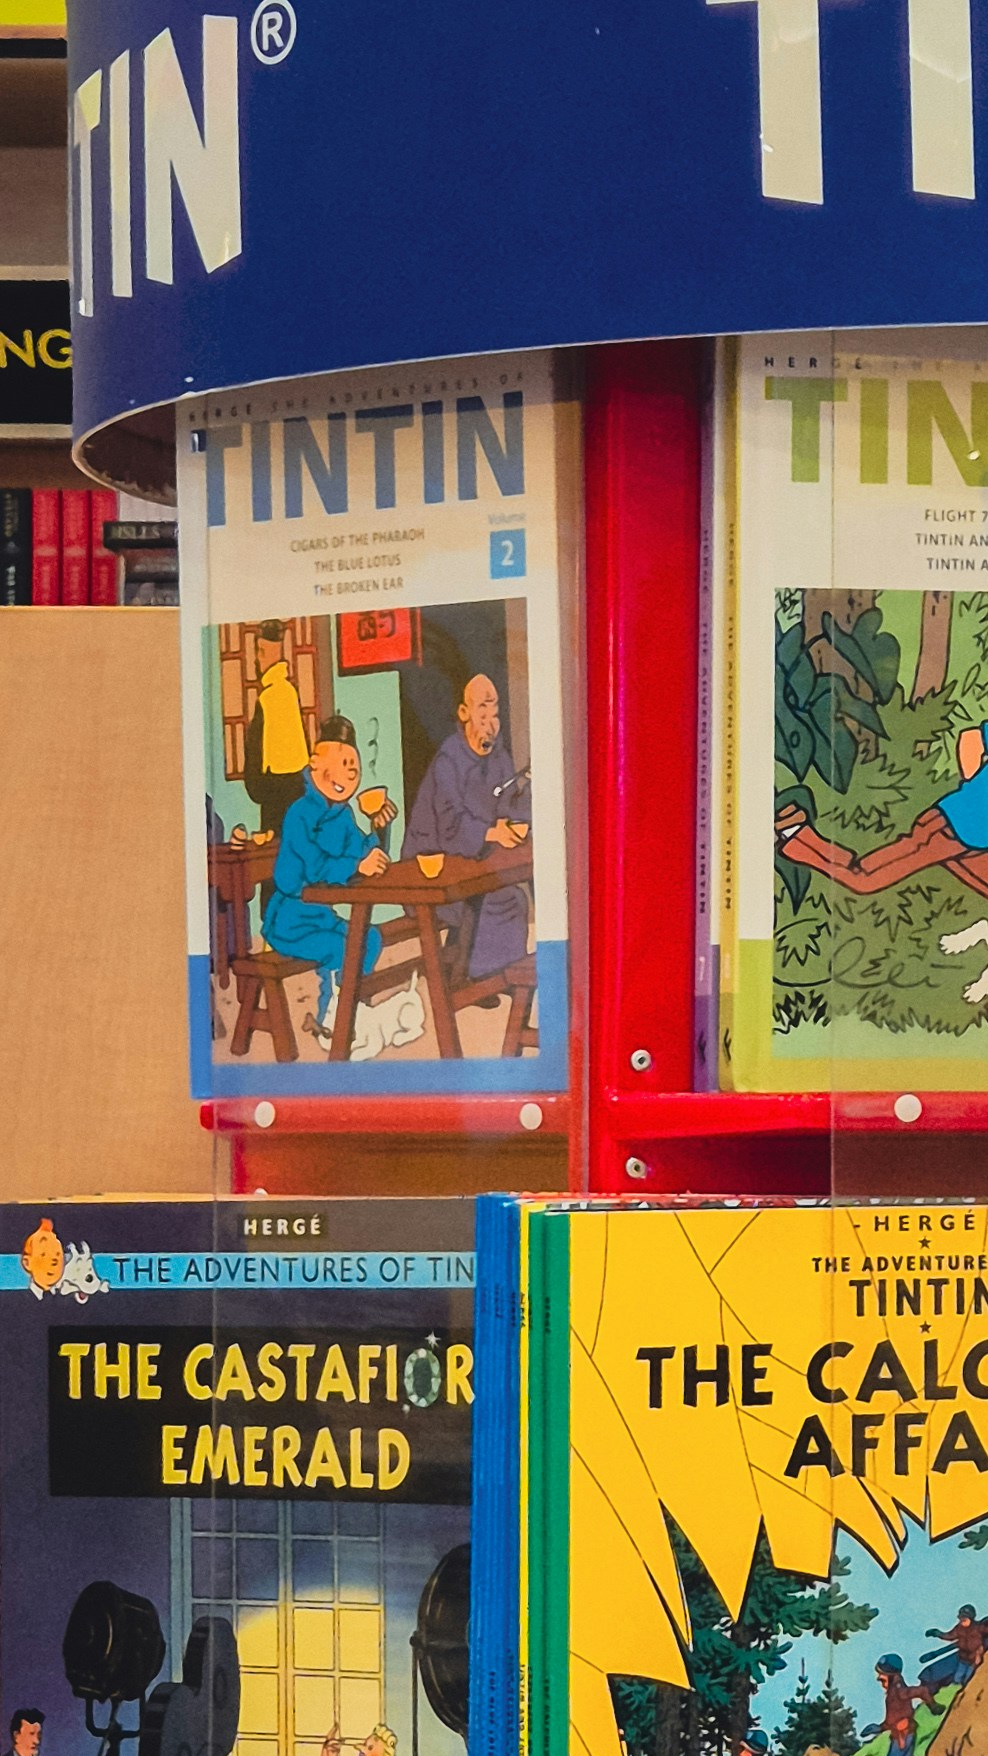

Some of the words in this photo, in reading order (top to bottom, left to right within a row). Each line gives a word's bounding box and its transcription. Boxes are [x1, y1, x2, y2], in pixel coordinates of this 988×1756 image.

[191, 391, 526, 528] TINTIN
[924, 509, 976, 524] FLIGHT
[290, 535, 331, 553] CIGARS
[332, 533, 346, 549] OF
[348, 531, 370, 548] THE
[372, 528, 426, 546] PHARAOH
[916, 532, 966, 548] TINTIN
[314, 560, 335, 575] THE
[337, 557, 364, 573] BLUE
[366, 554, 402, 571] LOTUS
[501, 540, 515, 567] 2
[926, 557, 977, 572] TINTIN
[313, 583, 334, 598] THE
[336, 579, 380, 596] BROKEN
[383, 575, 405, 592] EAR
[243, 1213, 322, 1236] HERGÉ
[874, 1209, 977, 1233] HERGÉ
[112, 1257, 171, 1283] THE
[184, 1255, 367, 1284] ADVENTURES
[379, 1256, 415, 1283] OF
[811, 1256, 852, 1274] THE
[58, 1343, 161, 1399] THE
[635, 1343, 774, 1410] THE
[161, 1424, 411, 1490] EMERALD
